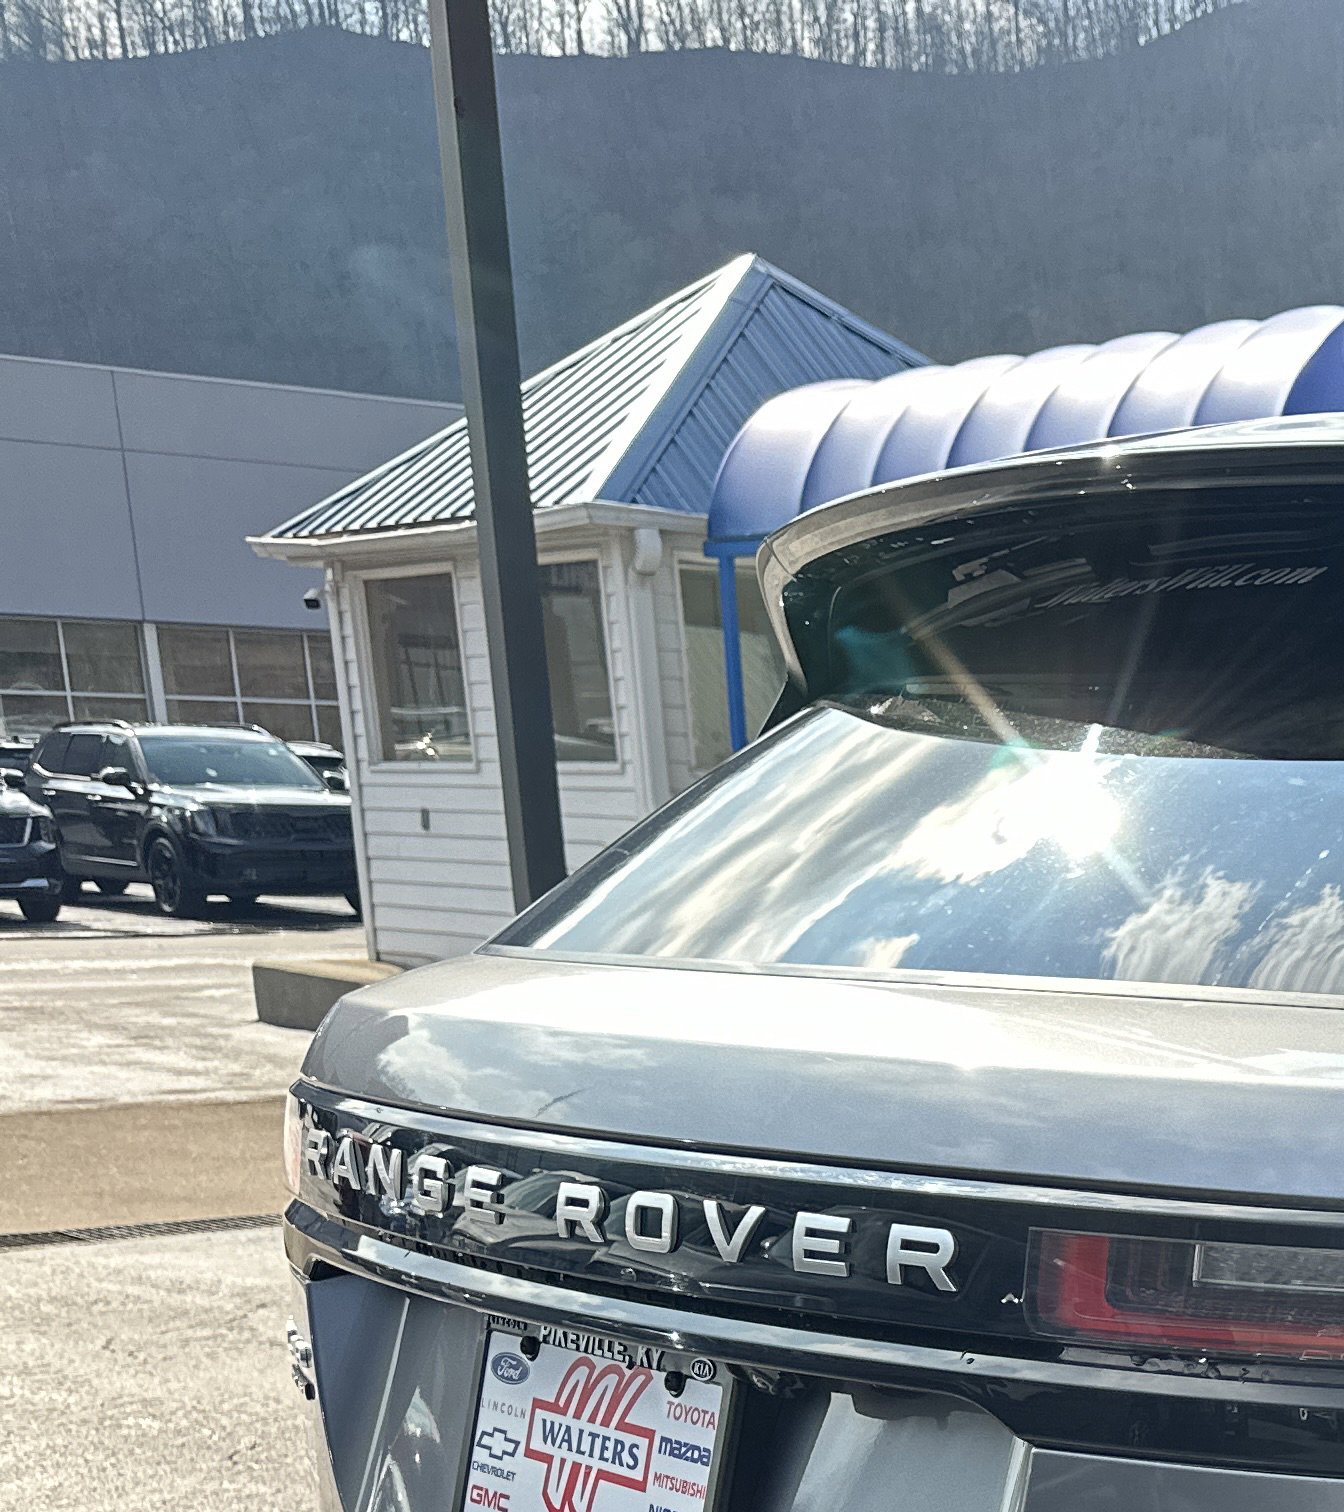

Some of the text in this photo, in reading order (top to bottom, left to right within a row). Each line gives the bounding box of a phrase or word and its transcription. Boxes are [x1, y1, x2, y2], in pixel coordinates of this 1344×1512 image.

[304, 1127, 959, 1292] RANGE ROVER
[496, 1357, 524, 1381] Ford
[637, 1345, 662, 1370] KY
[481, 1398, 527, 1419] LINCOLN
[666, 1400, 717, 1430] TOYOTA
[541, 1418, 640, 1470] WALTERS
[472, 1460, 517, 1482] CHEVROLET
[470, 1484, 511, 1512] GMC
[653, 1471, 706, 1500] MITSUBISHI
